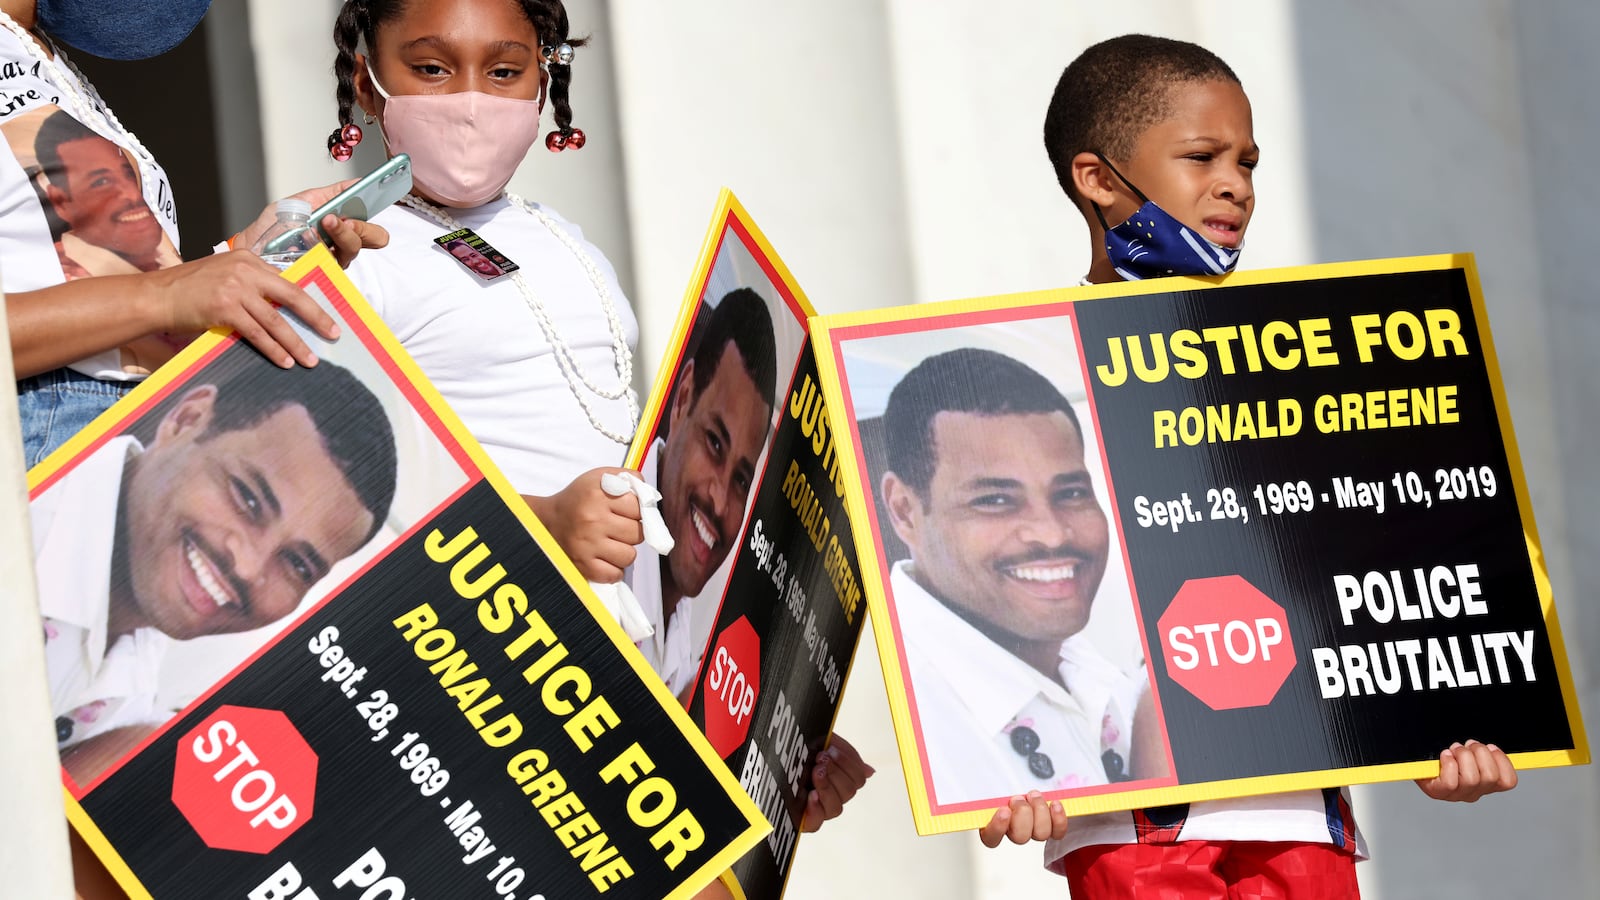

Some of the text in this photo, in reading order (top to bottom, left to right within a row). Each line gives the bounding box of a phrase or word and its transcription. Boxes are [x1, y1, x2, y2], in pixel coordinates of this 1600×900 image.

[1095, 308, 1469, 387] JUSTICE FOR
[1153, 385, 1460, 448] RONALD GREENE
[782, 459, 861, 627] RONALD GREENE
[1133, 495, 1203, 533] Sept.
[1207, 488, 1249, 524] 28,
[1253, 481, 1315, 516] 1969
[1332, 477, 1385, 514] May
[1391, 472, 1433, 509] 10,
[1435, 465, 1498, 501] 2019
[750, 519, 775, 574] Sept.
[771, 552, 788, 600] 28,
[785, 574, 807, 624] 1969
[803, 608, 821, 662] May
[815, 636, 829, 681] 10,
[822, 655, 840, 704] 2019
[1333, 564, 1489, 627] POLICE
[709, 646, 755, 726] STOP
[1167, 617, 1284, 671] STOP
[1311, 630, 1537, 700] BRUTALITY
[308, 625, 368, 699] Sept.
[356, 689, 399, 742] 28,
[390, 732, 451, 797] 1969
[443, 799, 497, 865] May
[424, 525, 707, 871] JUSTICE FOR
[767, 689, 809, 798] POLICE
[192, 720, 298, 830] STOP
[392, 602, 636, 894] RONALD GREENE
